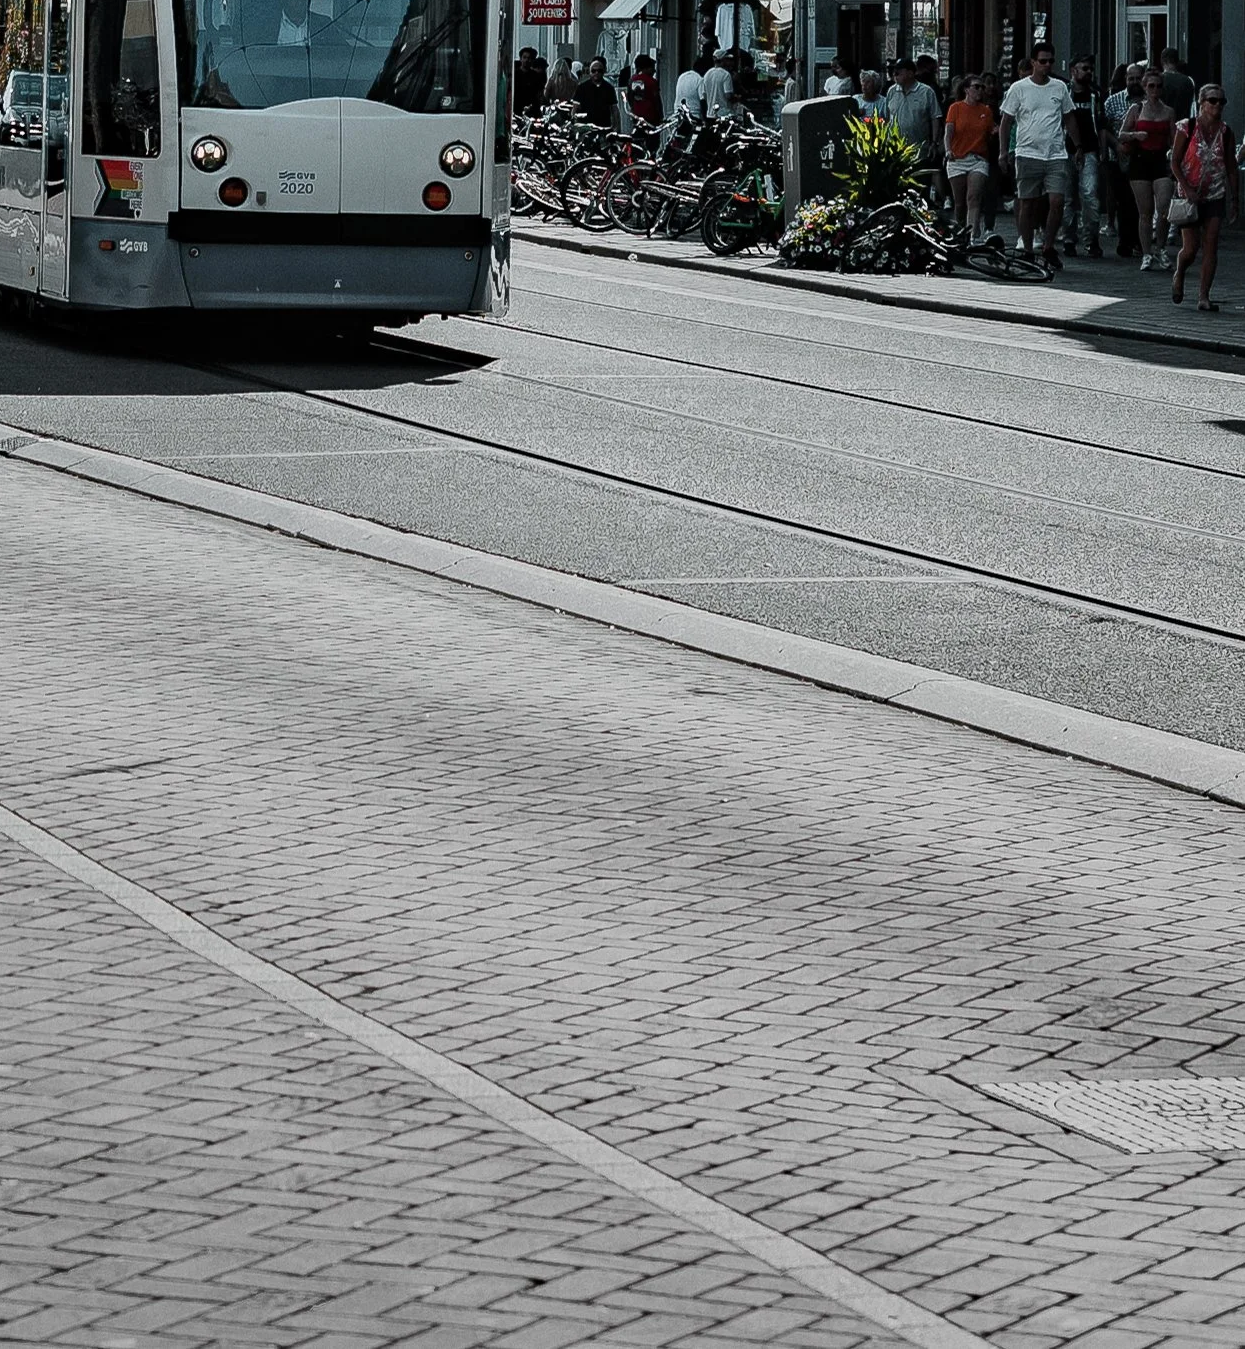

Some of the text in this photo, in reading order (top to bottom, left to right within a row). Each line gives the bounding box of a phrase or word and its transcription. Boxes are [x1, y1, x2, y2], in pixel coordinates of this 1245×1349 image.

[527, 7, 568, 22] SOUVENIRS
[296, 172, 316, 180] GVB
[279, 182, 314, 195] 2020
[133, 241, 149, 253] GVB
